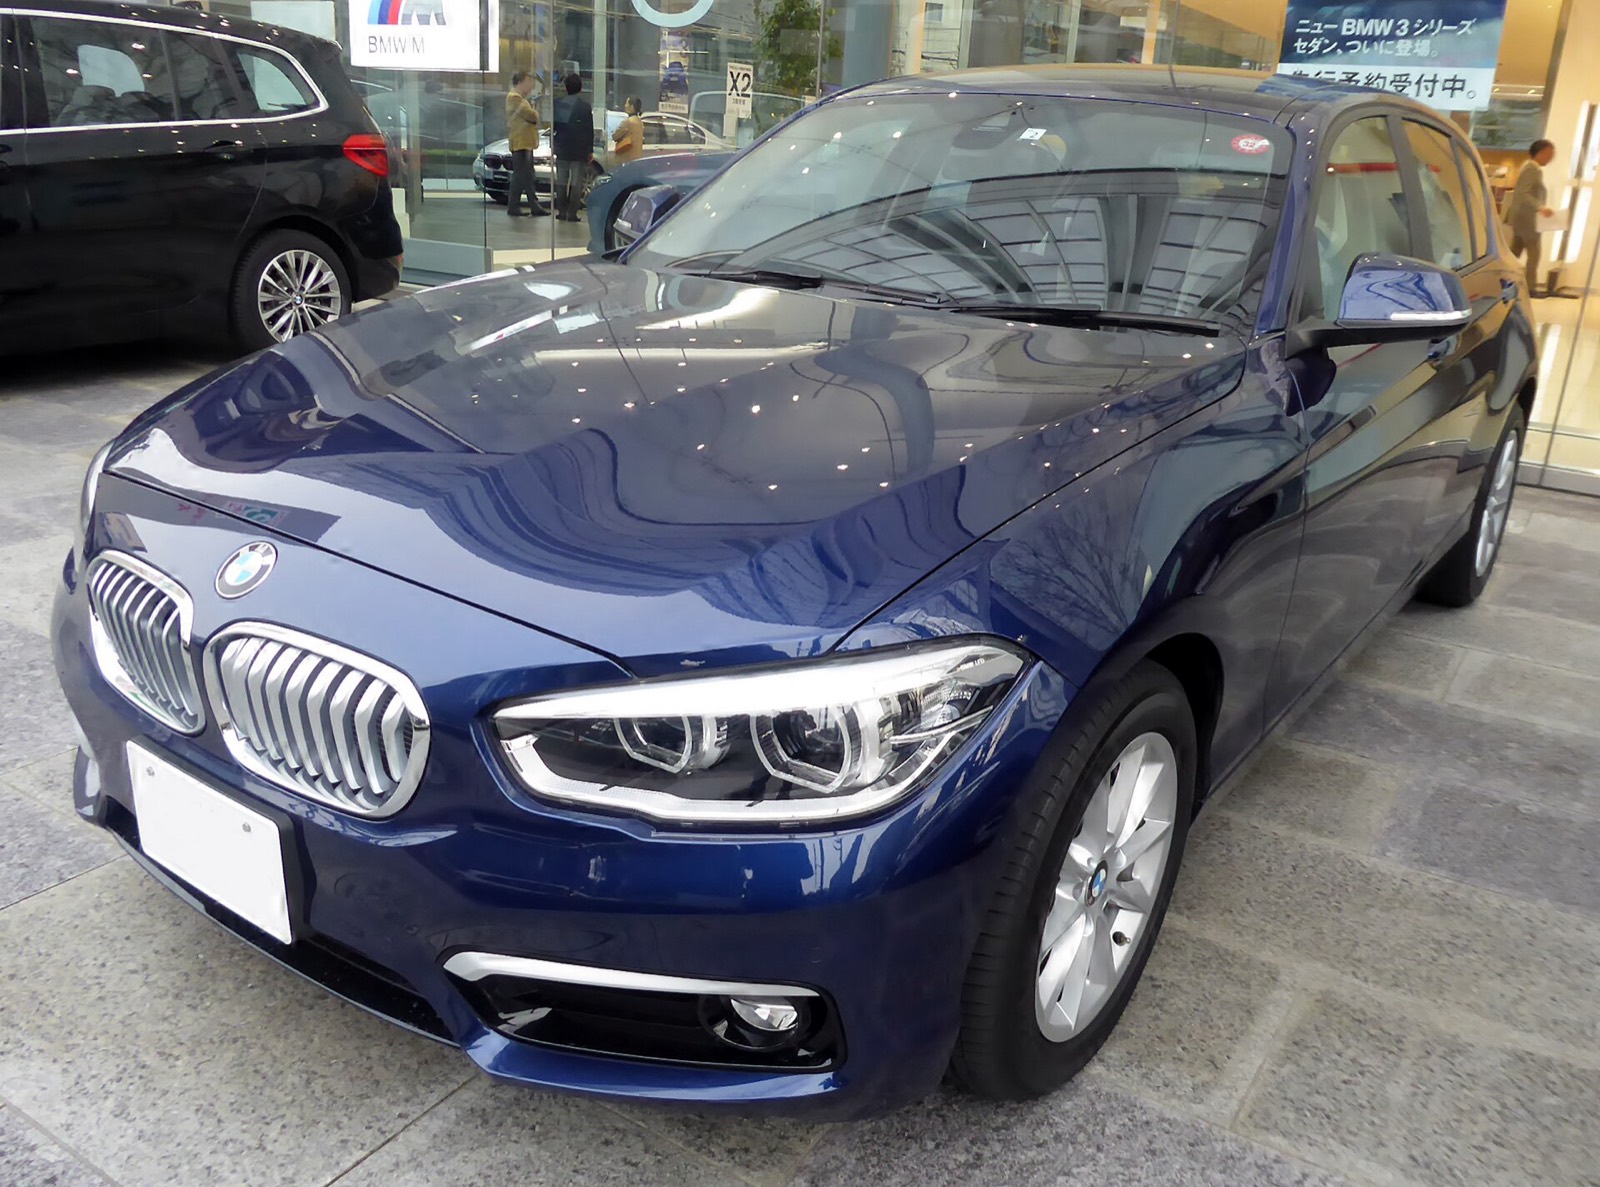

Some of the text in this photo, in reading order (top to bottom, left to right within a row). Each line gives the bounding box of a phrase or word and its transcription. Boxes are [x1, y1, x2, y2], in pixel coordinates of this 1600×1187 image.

[368, 36, 425, 54] BMW M
[728, 71, 752, 98] X2
[1242, 140, 1256, 148] 32
